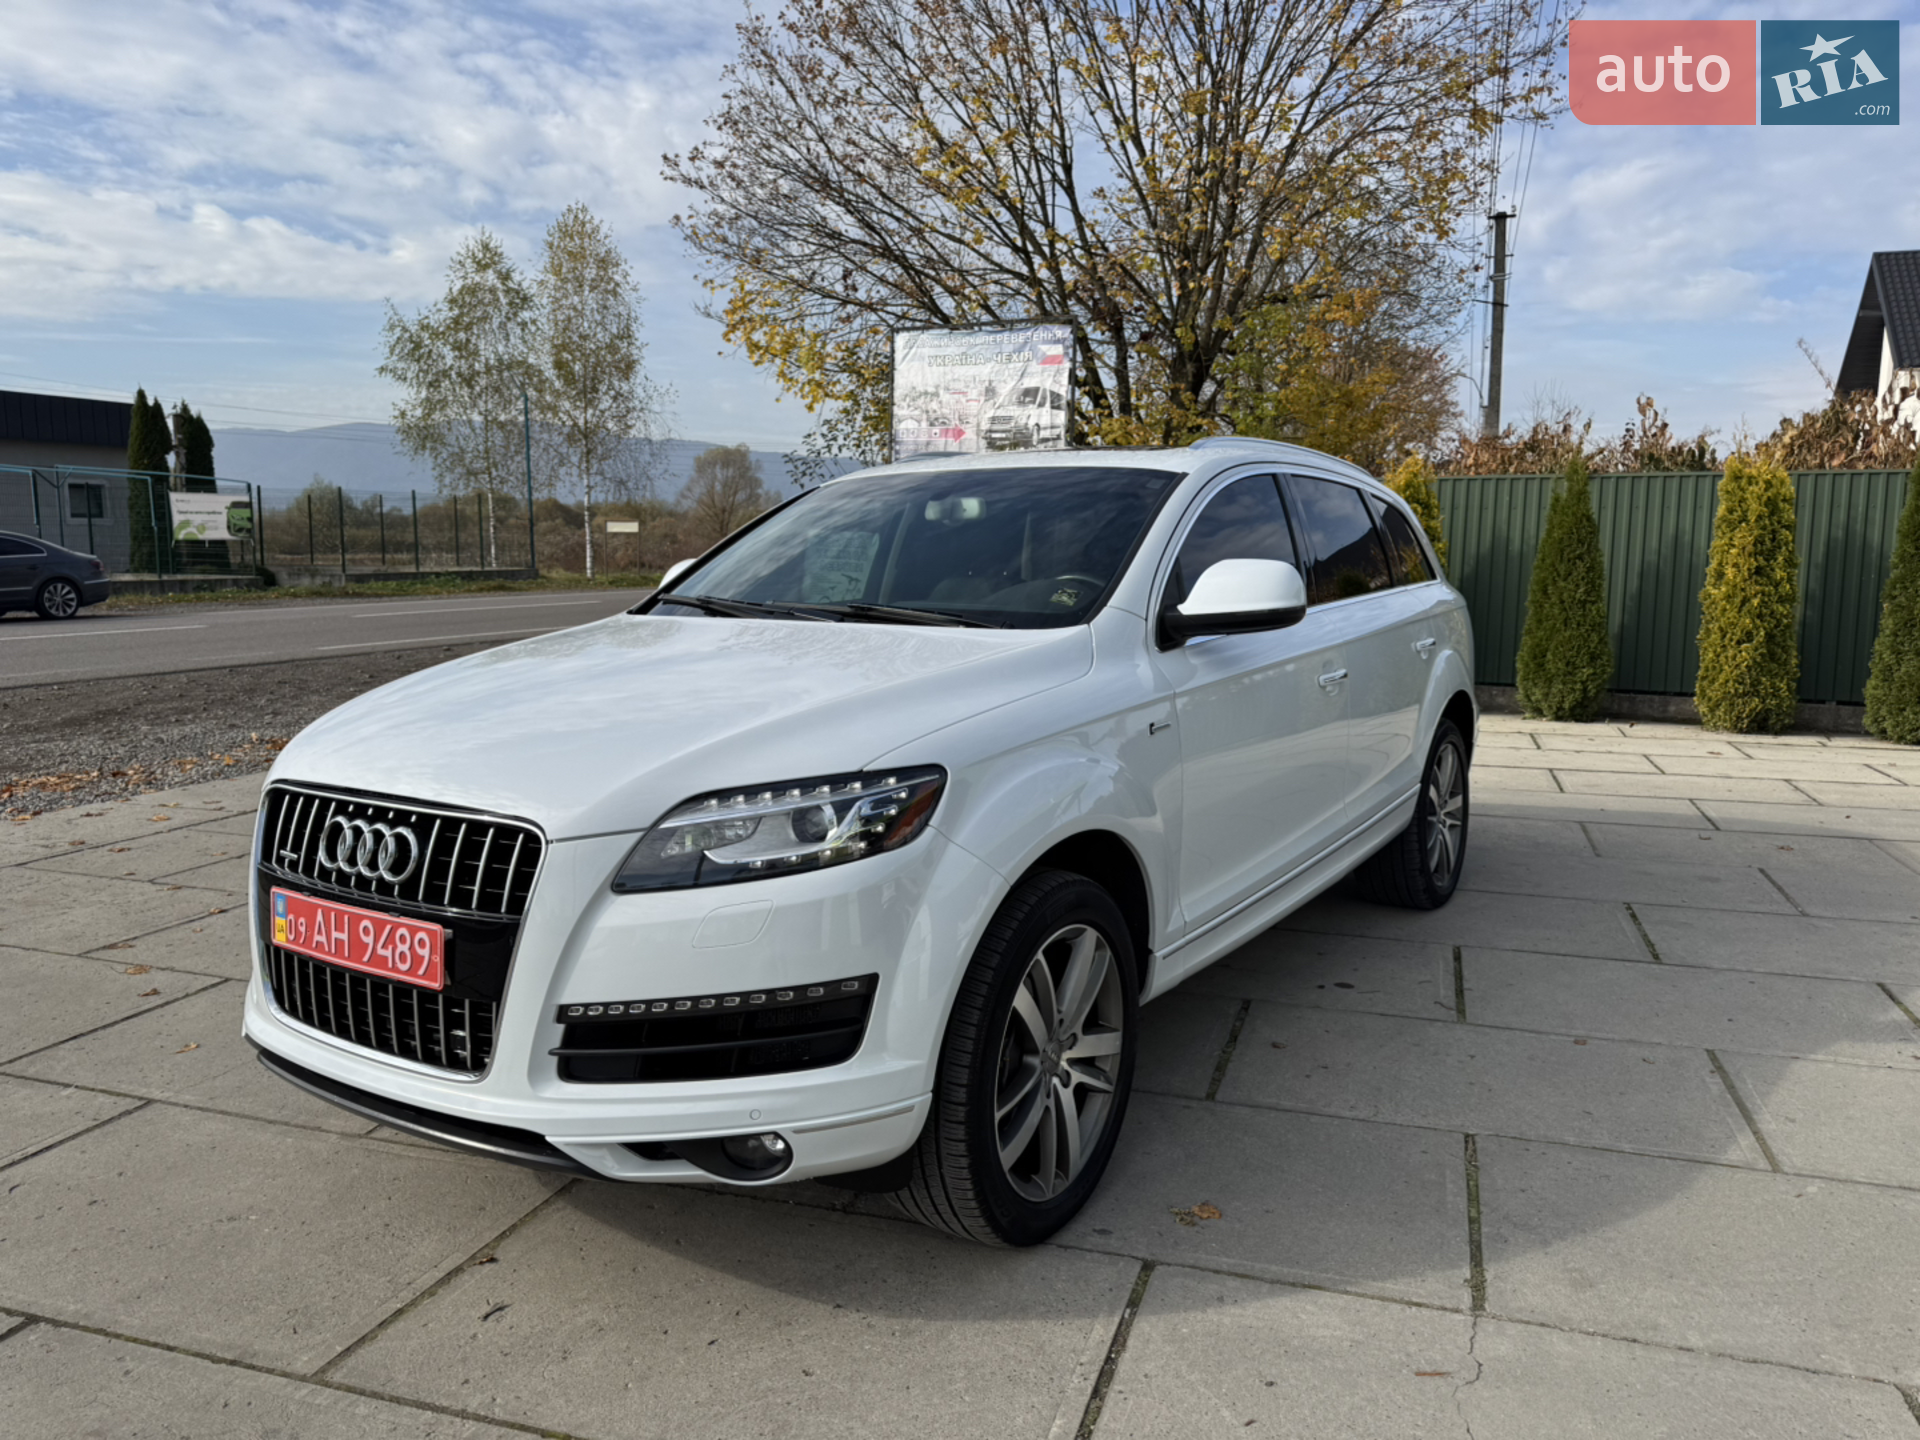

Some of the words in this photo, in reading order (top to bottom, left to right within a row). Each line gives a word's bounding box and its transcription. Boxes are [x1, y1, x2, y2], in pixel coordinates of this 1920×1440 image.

[983, 330, 1063, 345] ПЕРЕВЕЗЕННЯ
[928, 353, 985, 366] УКРАЇНА
[992, 351, 1033, 364] ЧЕХІЯ
[287, 913, 306, 943] 09
[312, 908, 350, 958] AH
[359, 920, 430, 976] 9489
